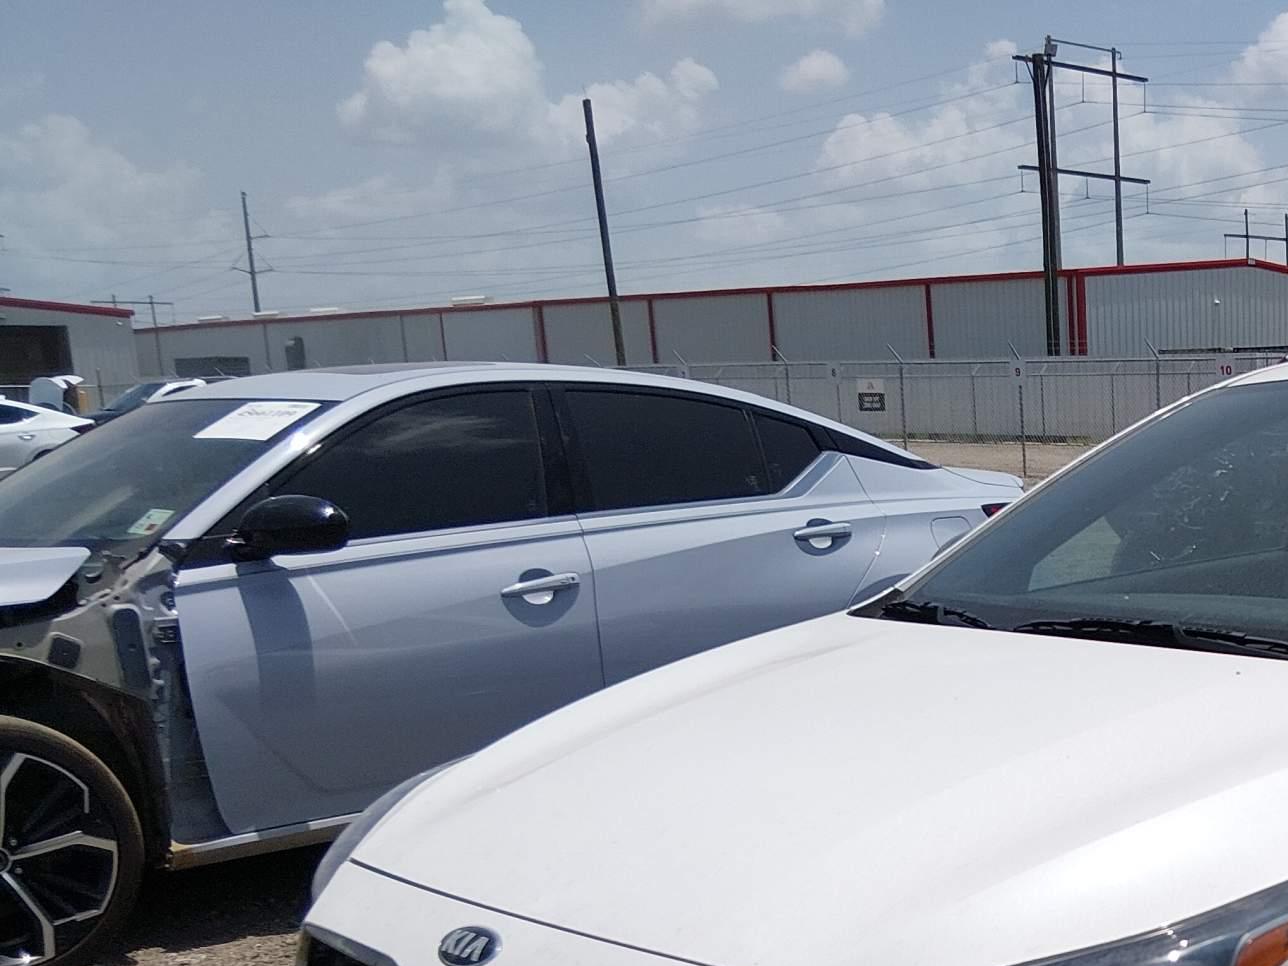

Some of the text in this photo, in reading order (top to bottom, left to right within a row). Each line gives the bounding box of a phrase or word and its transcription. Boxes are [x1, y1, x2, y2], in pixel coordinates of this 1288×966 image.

[1014, 367, 1021, 377] 9
[1220, 365, 1232, 376] 10
[441, 929, 489, 962] KIA
